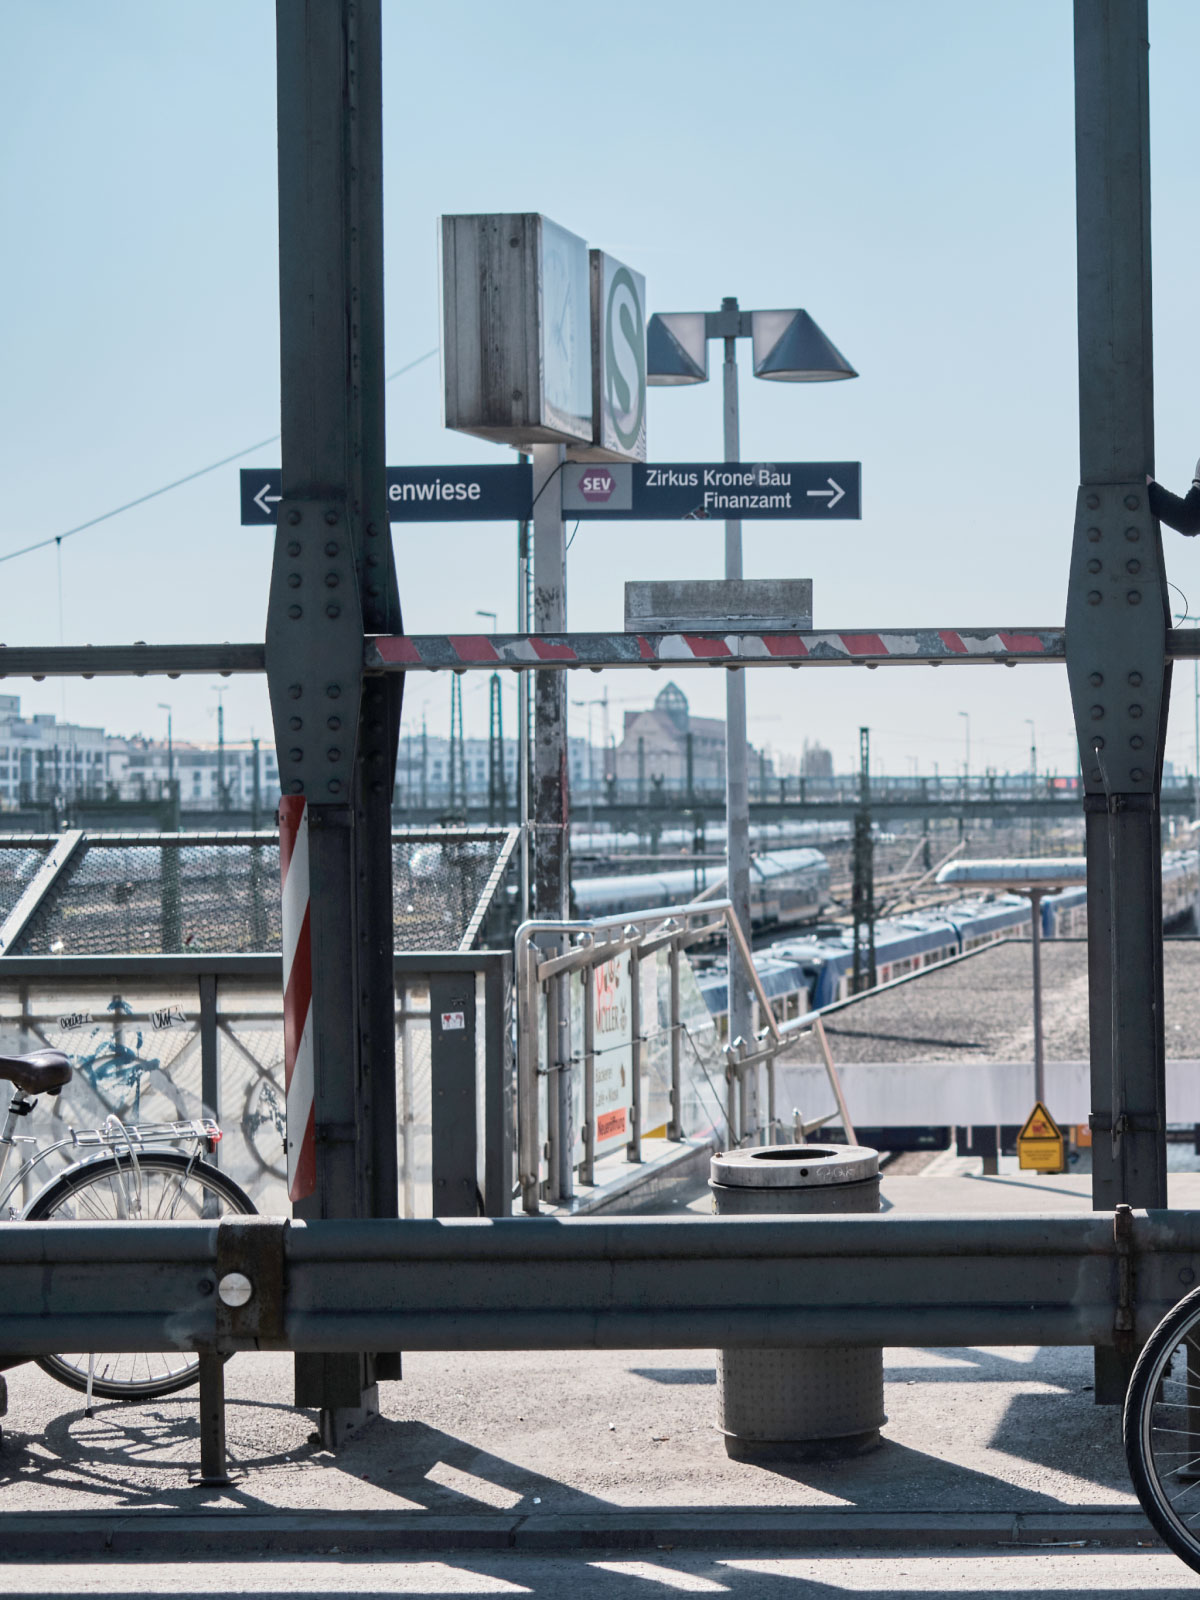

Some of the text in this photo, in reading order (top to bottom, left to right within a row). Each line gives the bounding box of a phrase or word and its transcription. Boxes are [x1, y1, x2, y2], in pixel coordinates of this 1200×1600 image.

[609, 281, 641, 436] S
[583, 477, 611, 491] SEV
[645, 469, 791, 487] Zirkus Krone Bau
[388, 478, 481, 501] enwiese
[703, 491, 792, 509] Finanzamt
